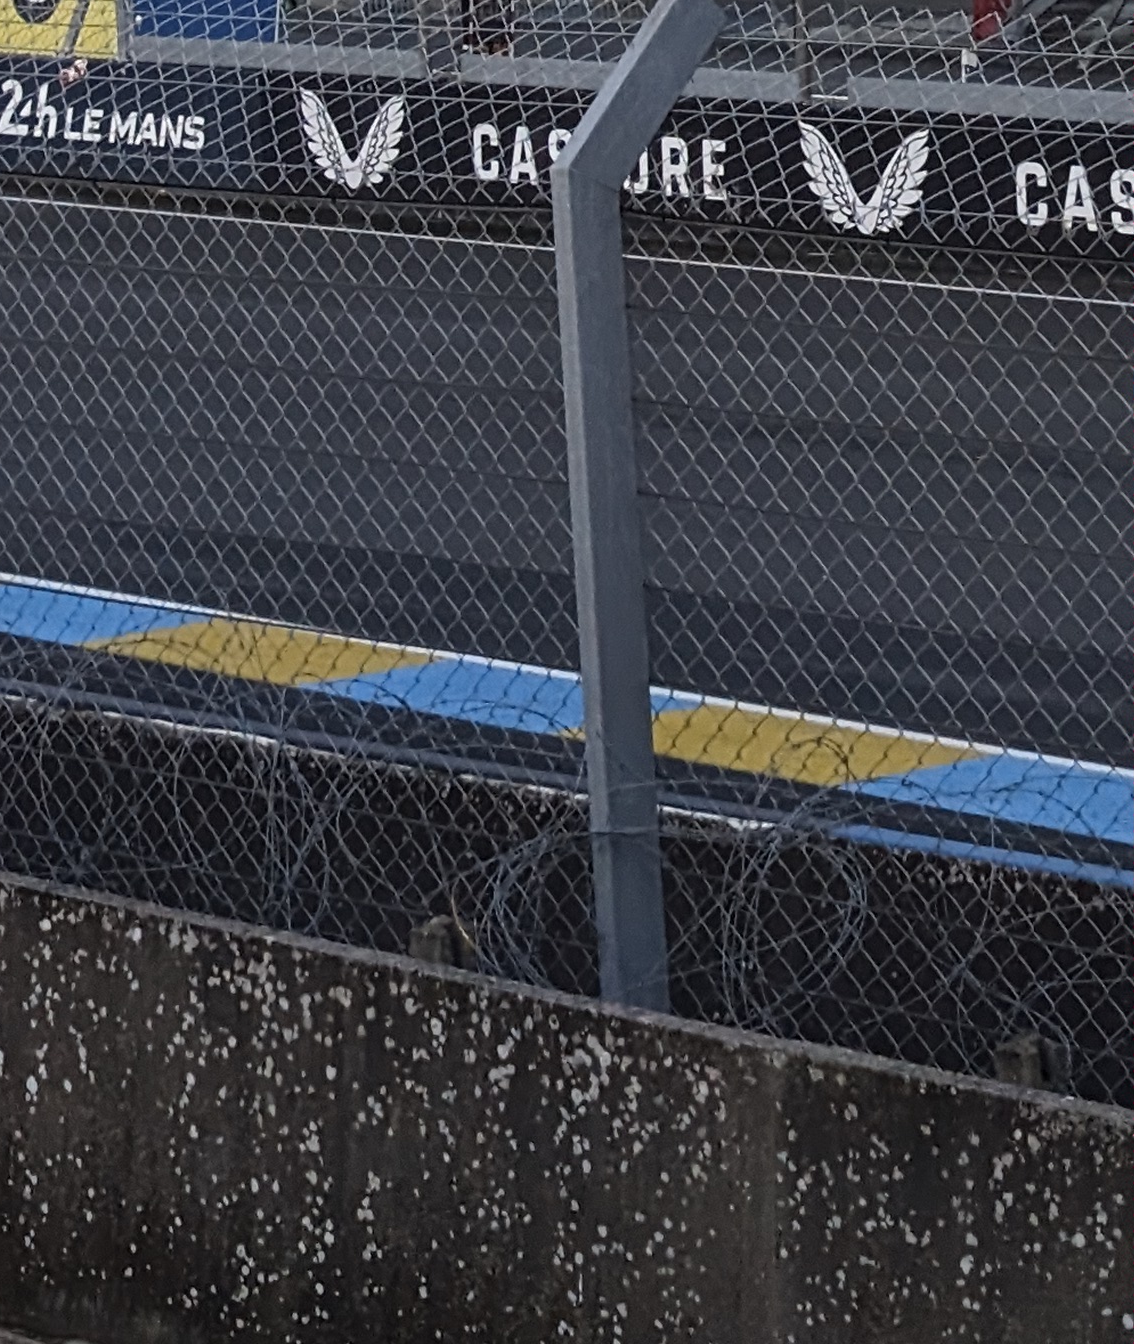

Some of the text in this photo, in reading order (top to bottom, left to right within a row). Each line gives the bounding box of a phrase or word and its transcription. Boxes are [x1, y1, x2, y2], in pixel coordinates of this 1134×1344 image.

[63, 107, 105, 143] LE
[107, 111, 206, 151] MANS
[472, 123, 727, 201] CARE
